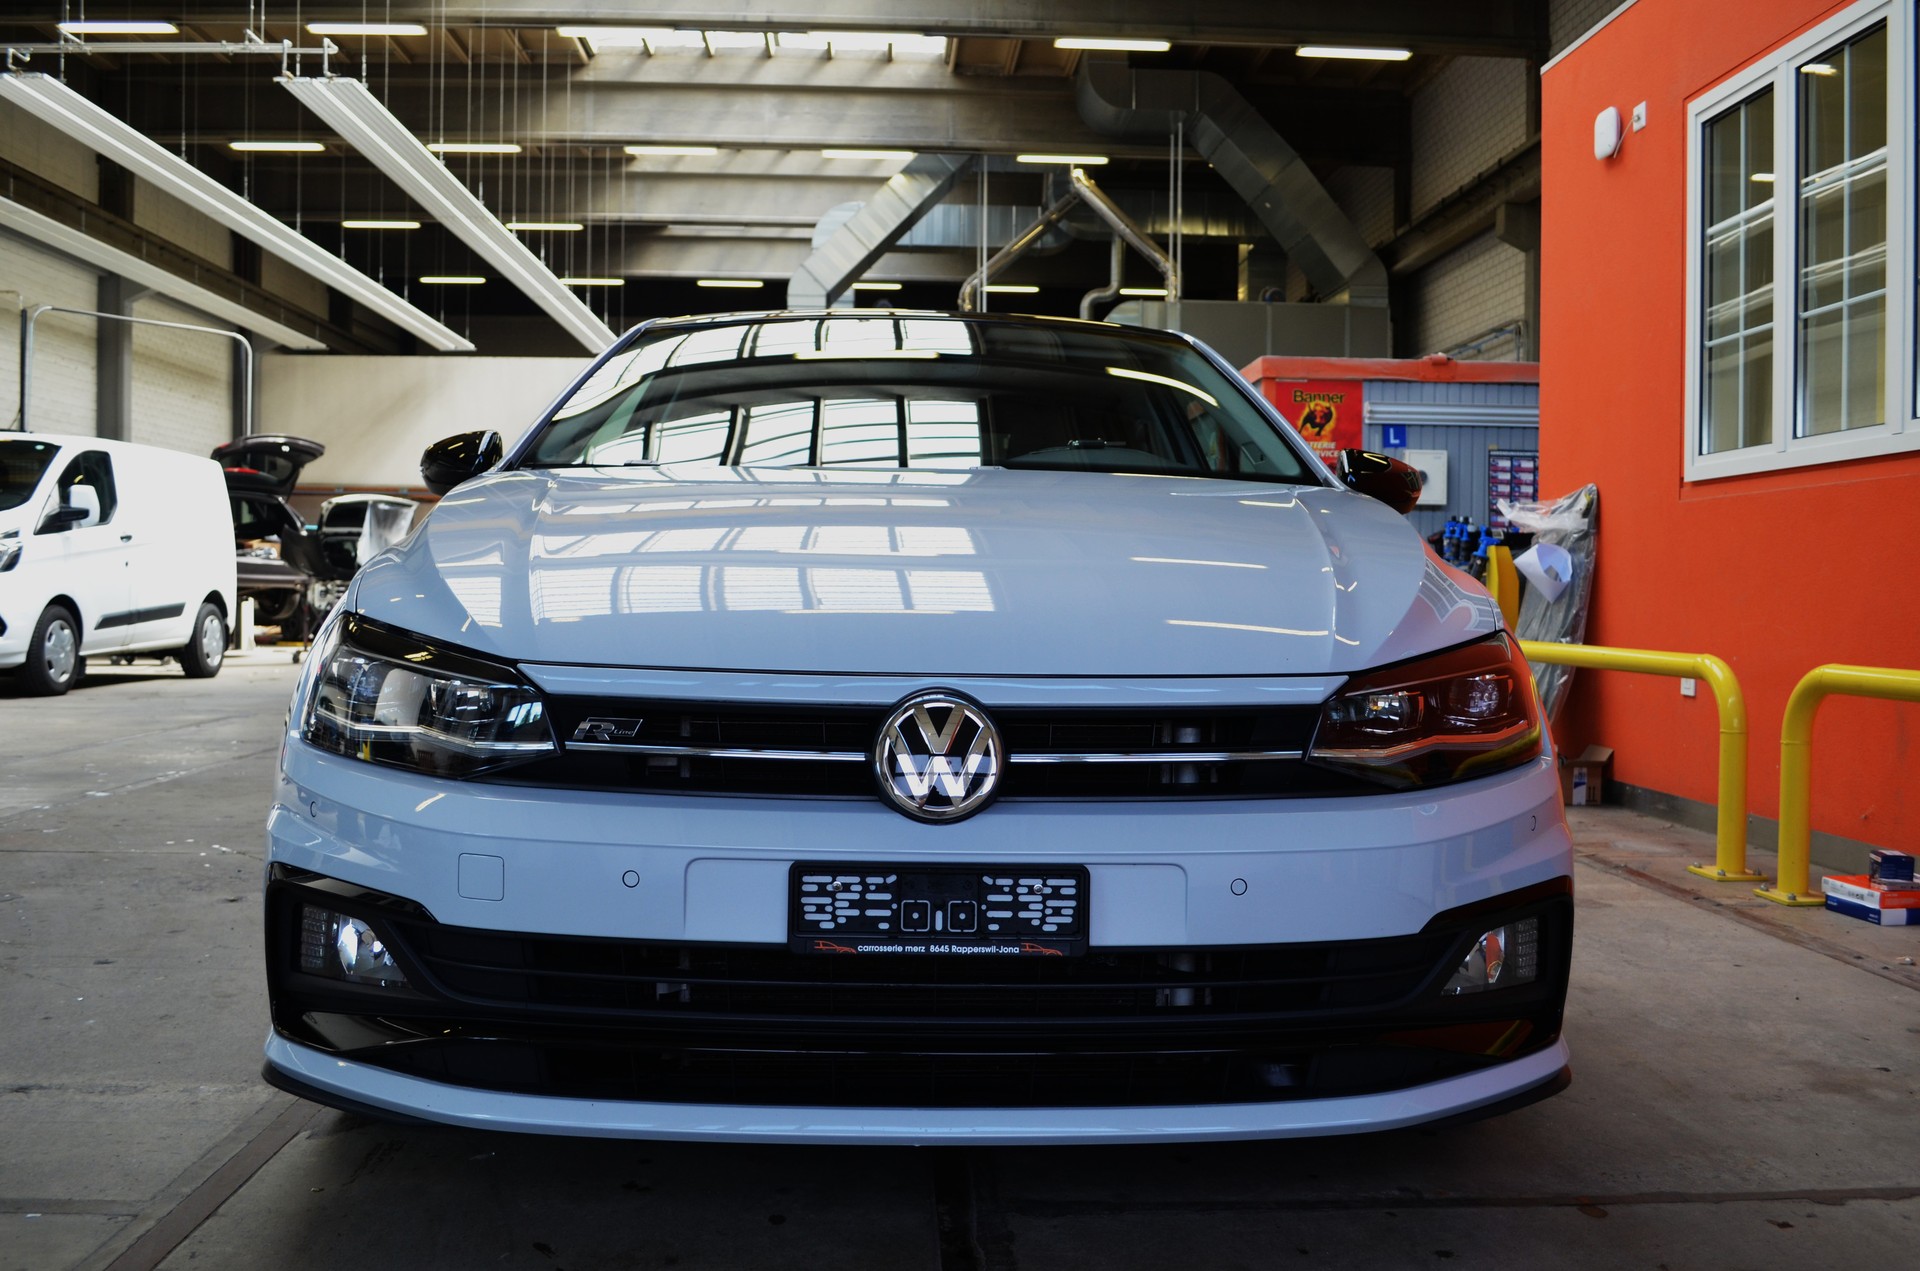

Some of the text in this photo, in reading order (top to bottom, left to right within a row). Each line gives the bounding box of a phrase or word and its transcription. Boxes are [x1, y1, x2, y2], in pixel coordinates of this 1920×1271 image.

[1293, 390, 1345, 403] Banner
[1389, 427, 1400, 444] L
[857, 944, 1019, 954] carrosserie merz 8645 Rapperswil-Jona
